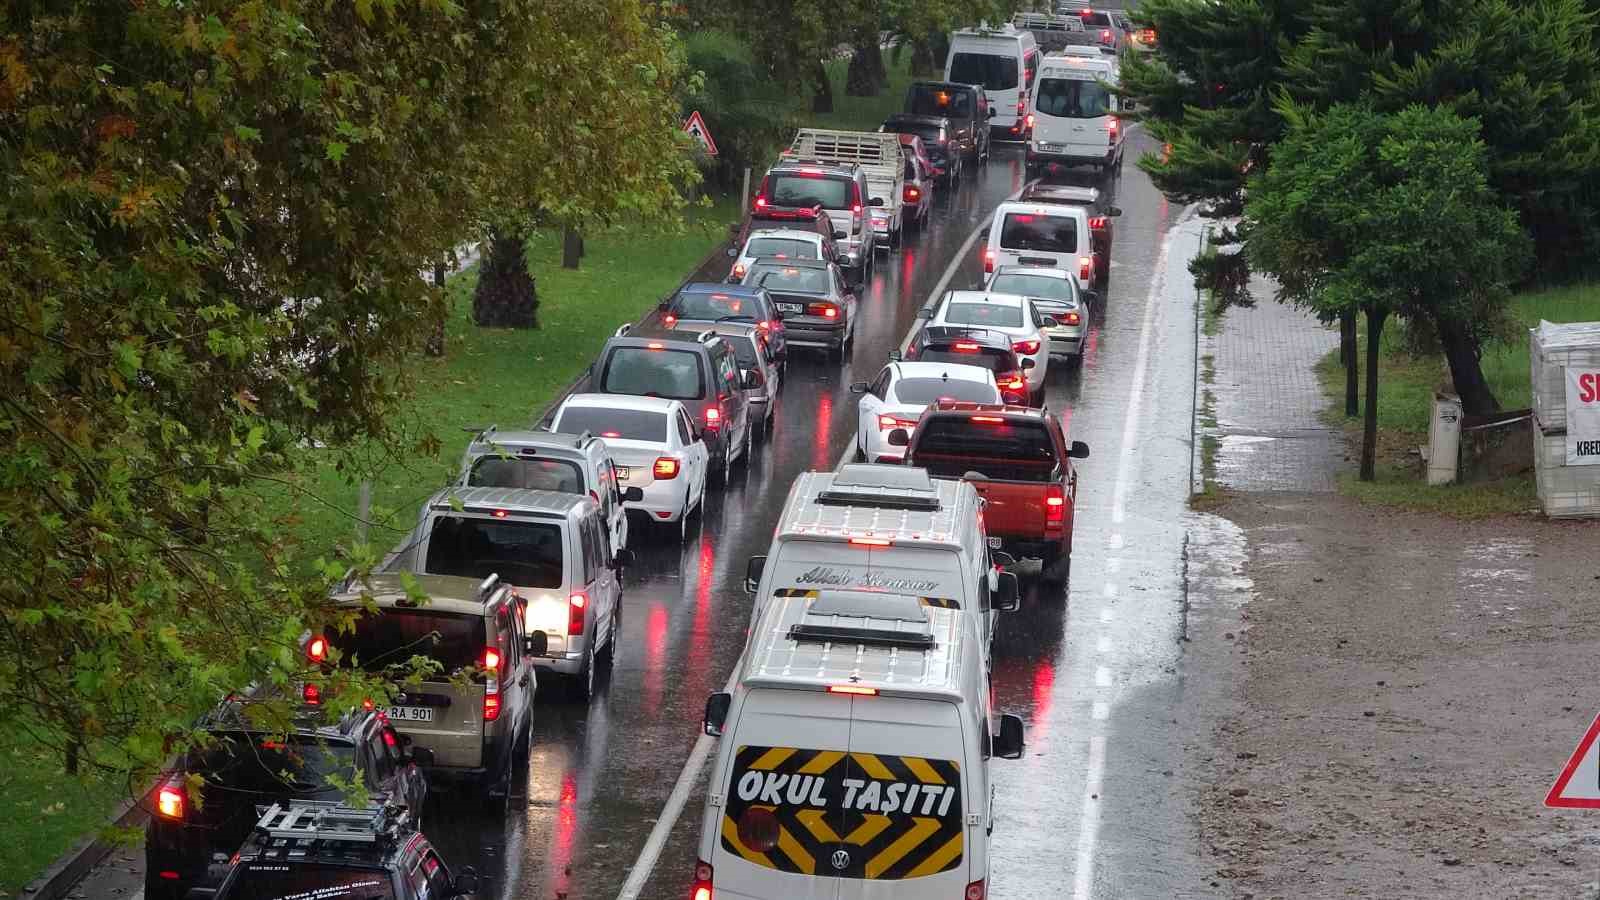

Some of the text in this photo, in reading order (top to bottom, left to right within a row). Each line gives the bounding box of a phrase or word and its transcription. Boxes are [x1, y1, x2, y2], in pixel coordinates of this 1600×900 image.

[391, 707, 432, 720] RA 901
[737, 770, 955, 817] OKUL TAŞITI
